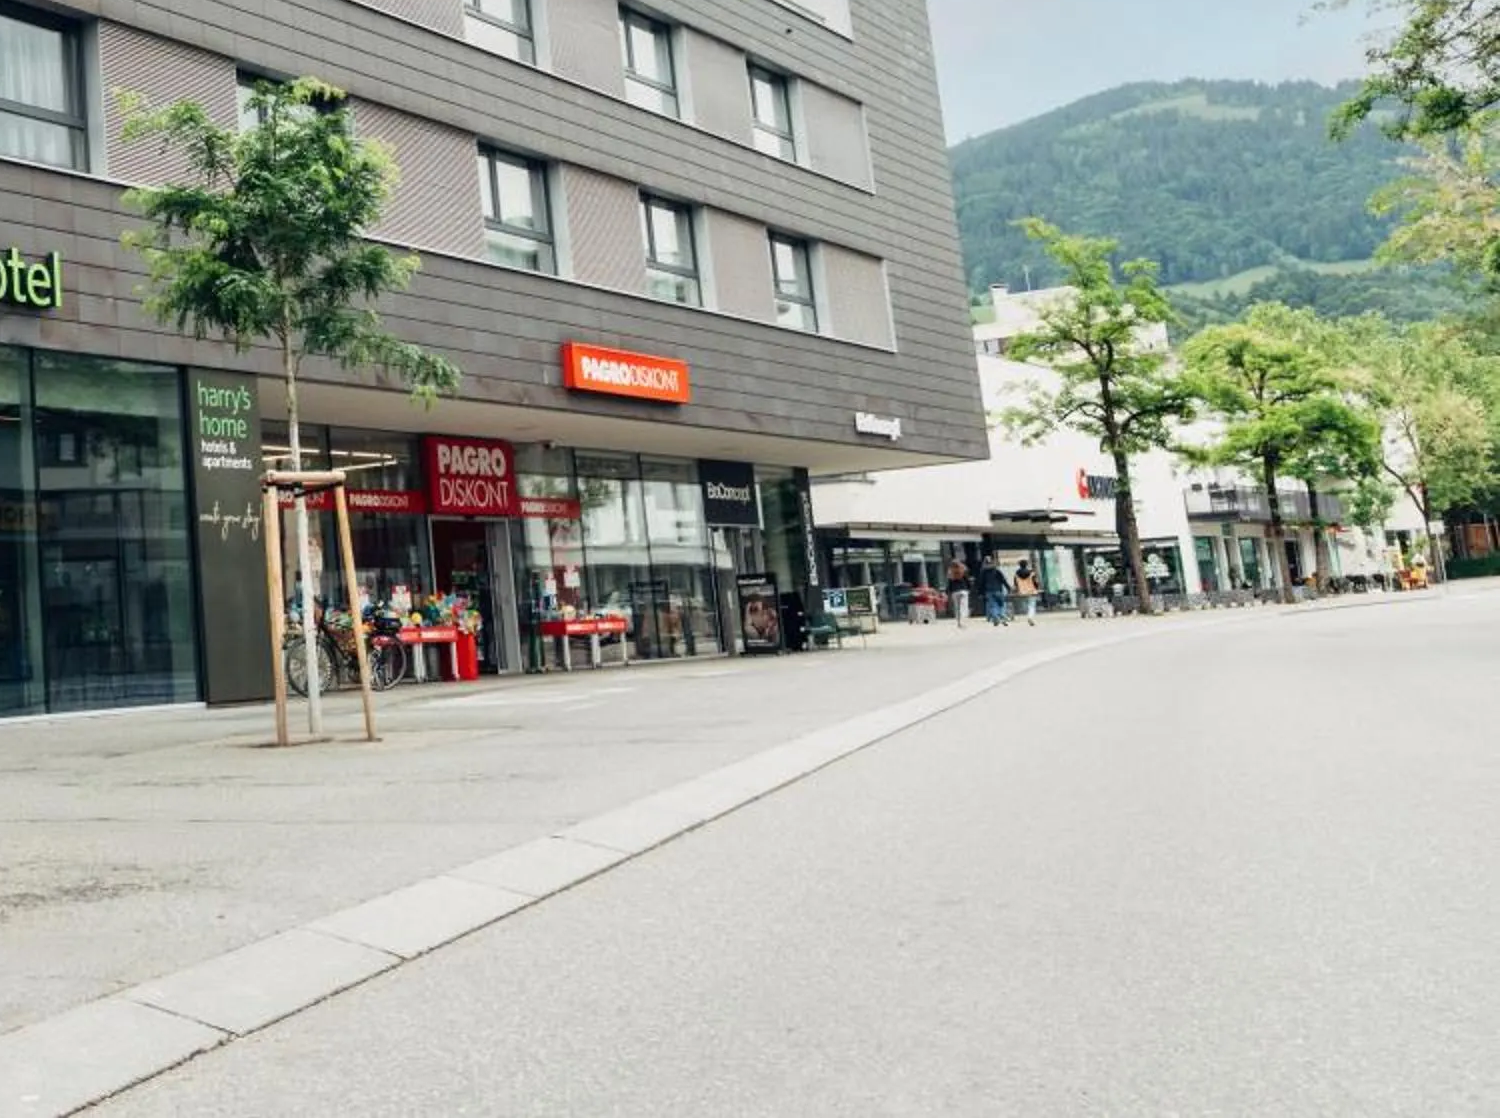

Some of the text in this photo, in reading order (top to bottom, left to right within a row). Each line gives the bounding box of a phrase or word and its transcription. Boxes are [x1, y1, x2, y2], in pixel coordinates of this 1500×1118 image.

[197, 380, 252, 415] harry's
[199, 409, 248, 438] home
[200, 438, 237, 455] hotels &
[437, 443, 506, 477] PAGRO
[201, 455, 253, 471] apartments
[439, 479, 509, 508] DISKONT
